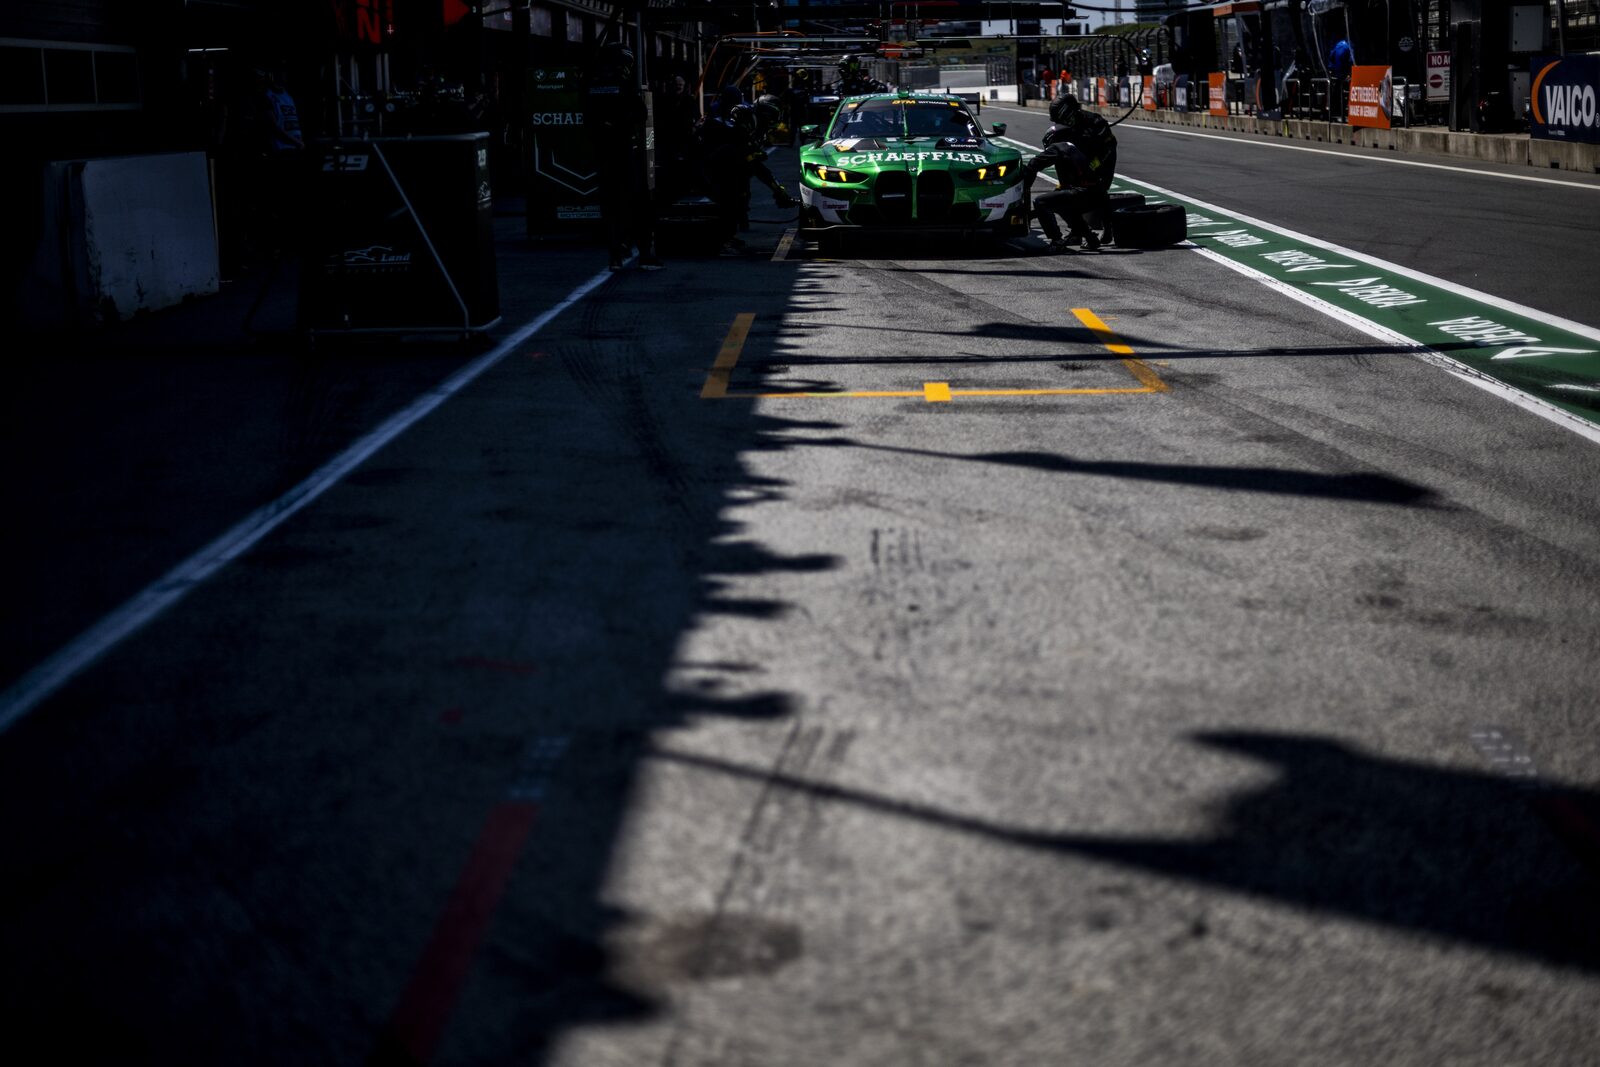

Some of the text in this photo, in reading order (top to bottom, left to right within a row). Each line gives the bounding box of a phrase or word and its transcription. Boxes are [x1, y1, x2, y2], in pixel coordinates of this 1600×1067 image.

[1431, 55, 1443, 66] NO
[1545, 84, 1596, 127] VAICO
[836, 151, 990, 167] SCHAEFFLER
[1338, 284, 1429, 308] DEKRA
[1426, 316, 1542, 346] DEKRA
